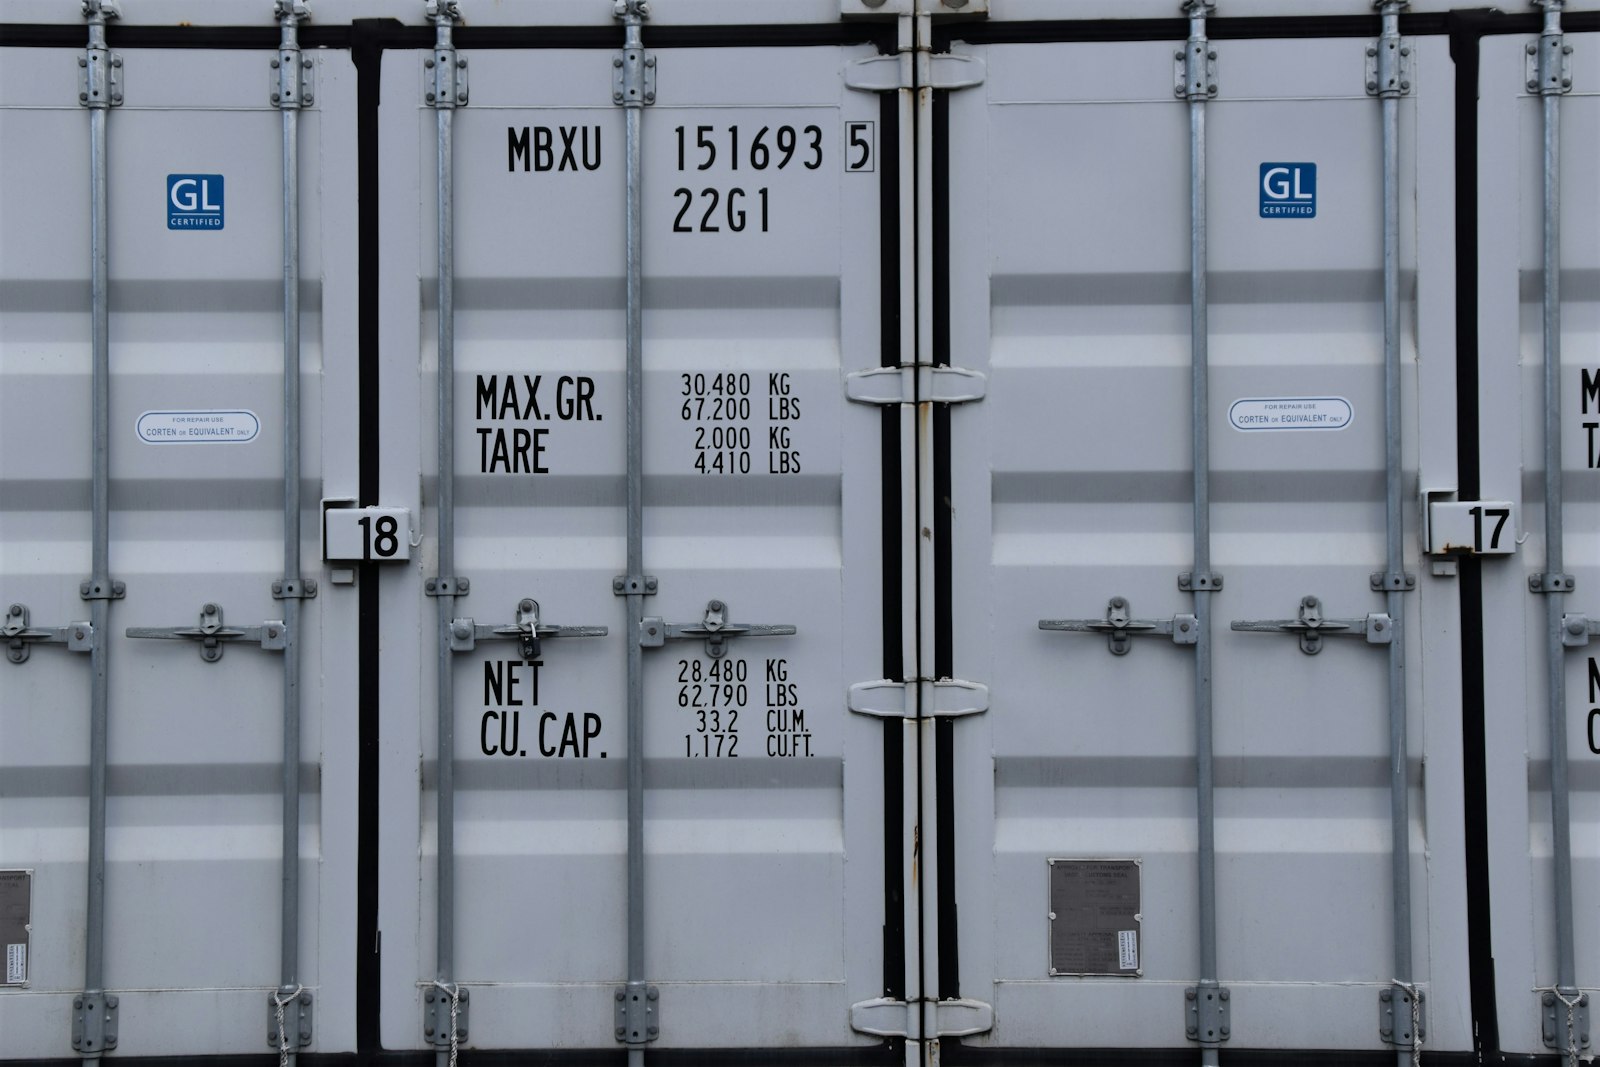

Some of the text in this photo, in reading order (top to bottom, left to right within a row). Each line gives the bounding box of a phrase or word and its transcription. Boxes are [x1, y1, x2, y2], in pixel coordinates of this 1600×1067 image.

[508, 125, 869, 172] MBXU 151693 5
[170, 178, 221, 211] GL
[1263, 167, 1313, 199] GL
[170, 218, 221, 226] CERTIFIED
[673, 188, 768, 232] 22G1
[1263, 206, 1313, 214] CERTIFIED
[682, 373, 750, 395] 30,480
[770, 373, 789, 395] KG
[682, 398, 800, 420] 67,200 LBS
[1238, 415, 1269, 423] CORTEN
[1281, 414, 1327, 423] EQUIVALENT
[146, 428, 177, 436] CORTEN
[188, 427, 235, 436] EQUIVALENT
[477, 427, 790, 473] TARE 2,000 KG
[695, 451, 800, 474] 4,410 LBS
[358, 515, 398, 560] 18
[1469, 506, 1510, 552] 17
[485, 658, 787, 705] NET 28,480 KG
[679, 684, 797, 707] 62,790 LBS
[481, 710, 808, 758] CU. CAP. 33.2 CU.M.
[686, 734, 814, 757] 1,172 CU.FT.
